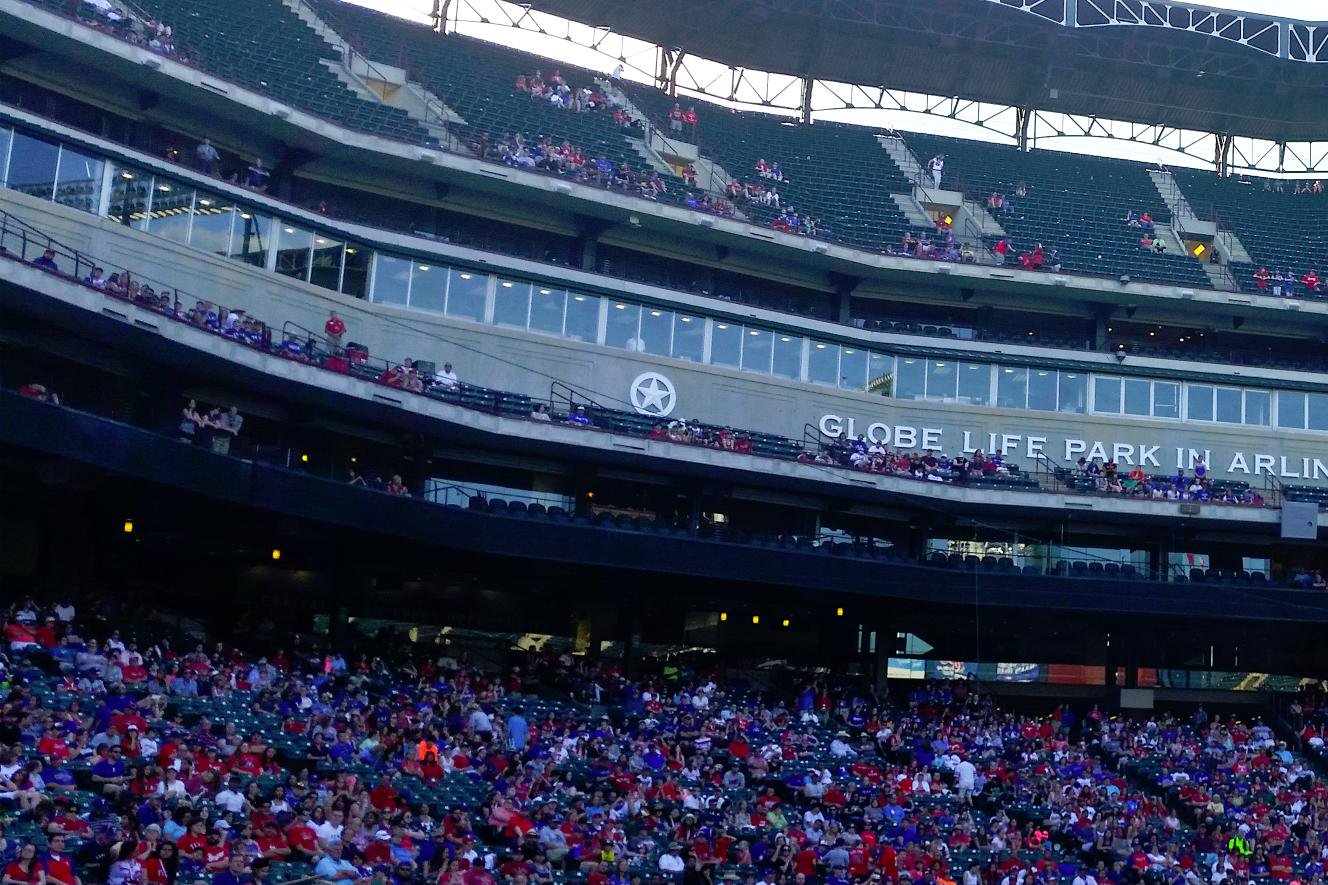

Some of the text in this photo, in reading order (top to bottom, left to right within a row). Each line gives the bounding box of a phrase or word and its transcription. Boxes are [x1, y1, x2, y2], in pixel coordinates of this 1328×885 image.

[819, 414, 943, 451] GLOBE
[963, 431, 1047, 459] LIFE
[1064, 439, 1161, 467] PARK
[1175, 447, 1211, 471] IN
